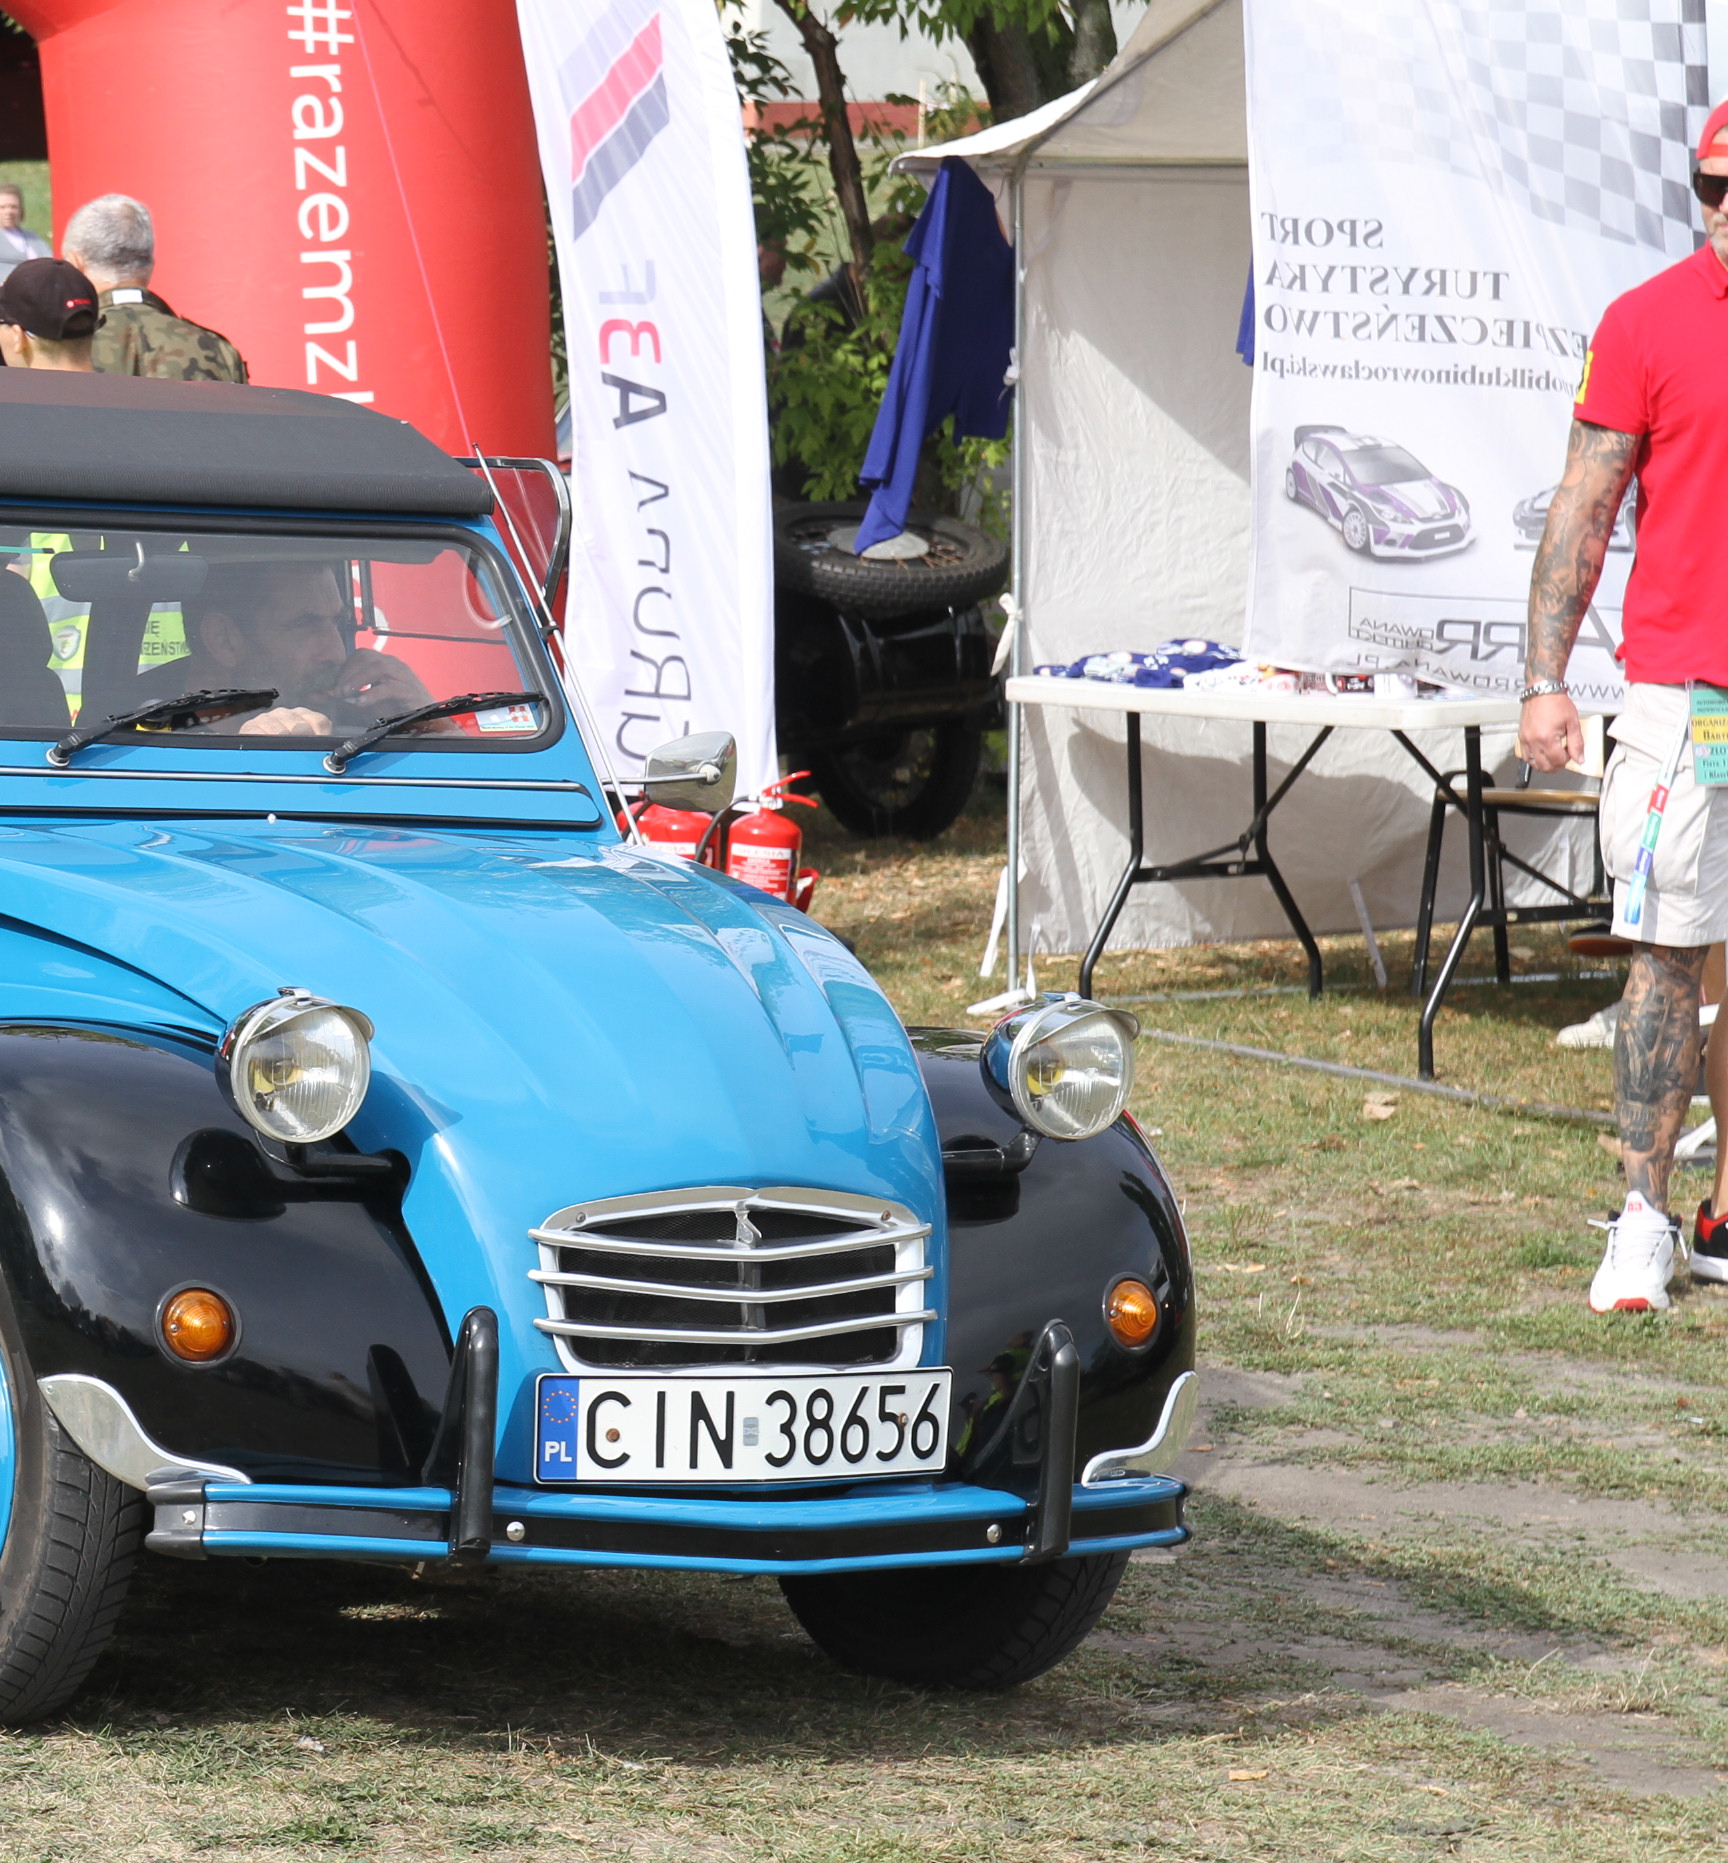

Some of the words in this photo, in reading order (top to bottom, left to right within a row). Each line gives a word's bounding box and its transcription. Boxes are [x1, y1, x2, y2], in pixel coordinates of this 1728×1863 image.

[146, 621, 160, 637] IĘ
[586, 1390, 734, 1470] CIN
[764, 1382, 941, 1468] 38656
[544, 1440, 572, 1463] PL
